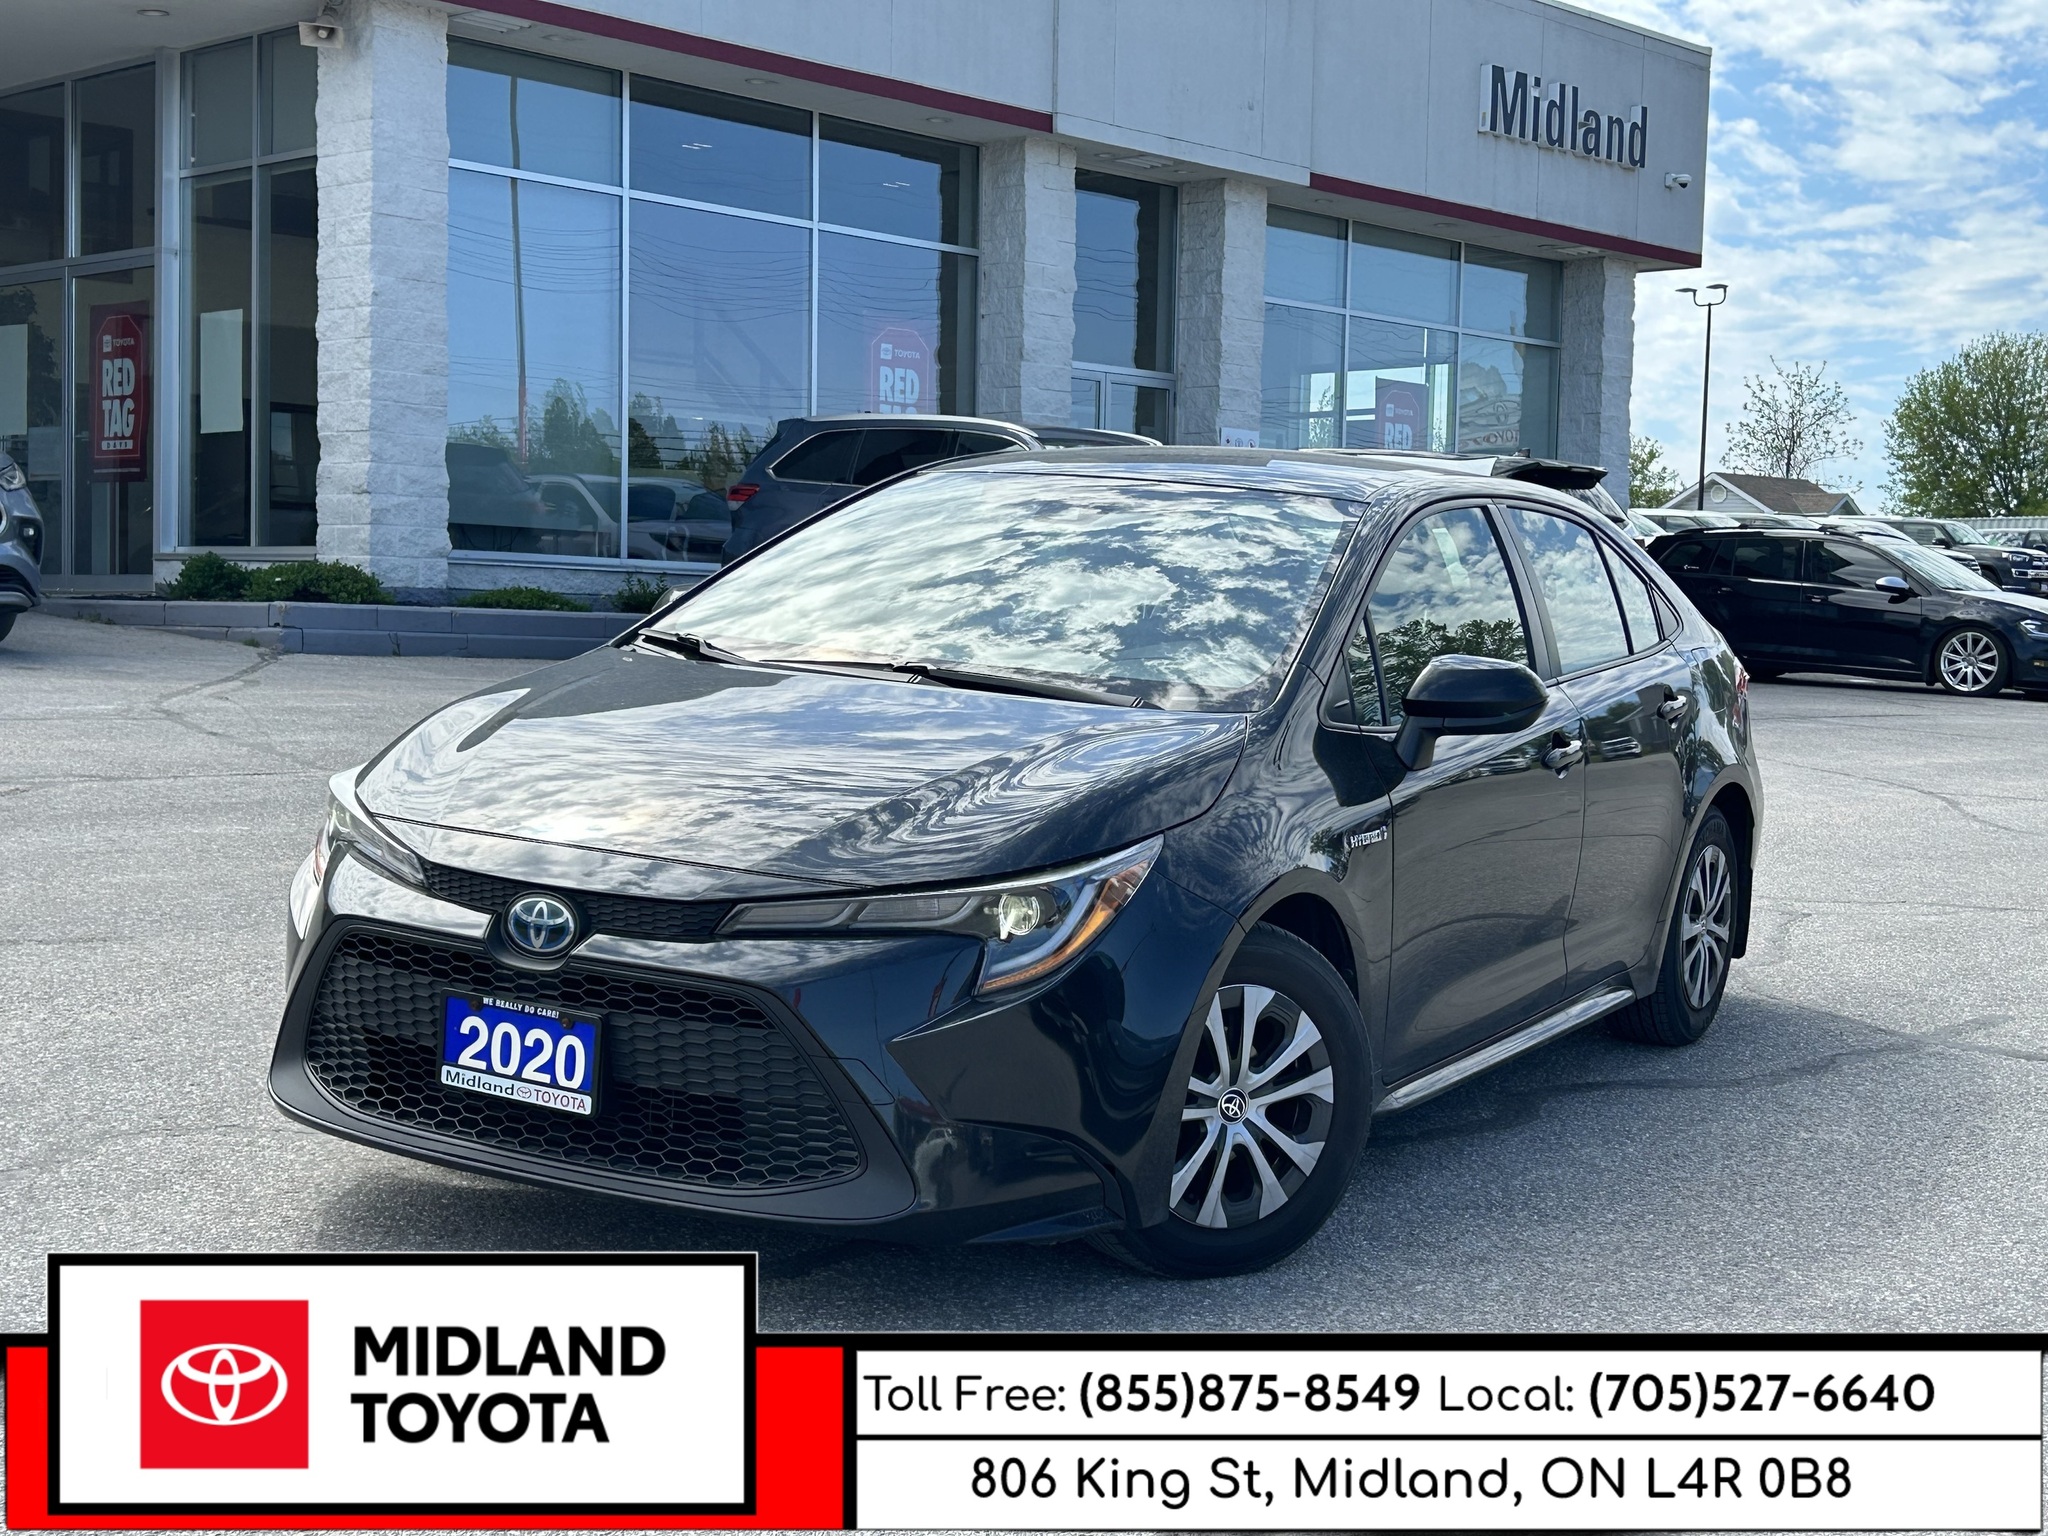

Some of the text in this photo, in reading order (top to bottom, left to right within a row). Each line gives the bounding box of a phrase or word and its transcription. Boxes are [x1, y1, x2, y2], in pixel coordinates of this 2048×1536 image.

[1484, 63, 1648, 169] Midland
[112, 337, 135, 347] TOYOTA
[894, 349, 921, 359] TOYOTA
[102, 358, 136, 397] RED
[879, 365, 920, 404] RED
[101, 398, 135, 438] TAG
[1384, 421, 1413, 450] RED
[482, 997, 560, 1019] WE REALLY DO CARE!
[457, 1015, 586, 1090] 2020
[445, 1069, 587, 1112] Midland TOYOTA
